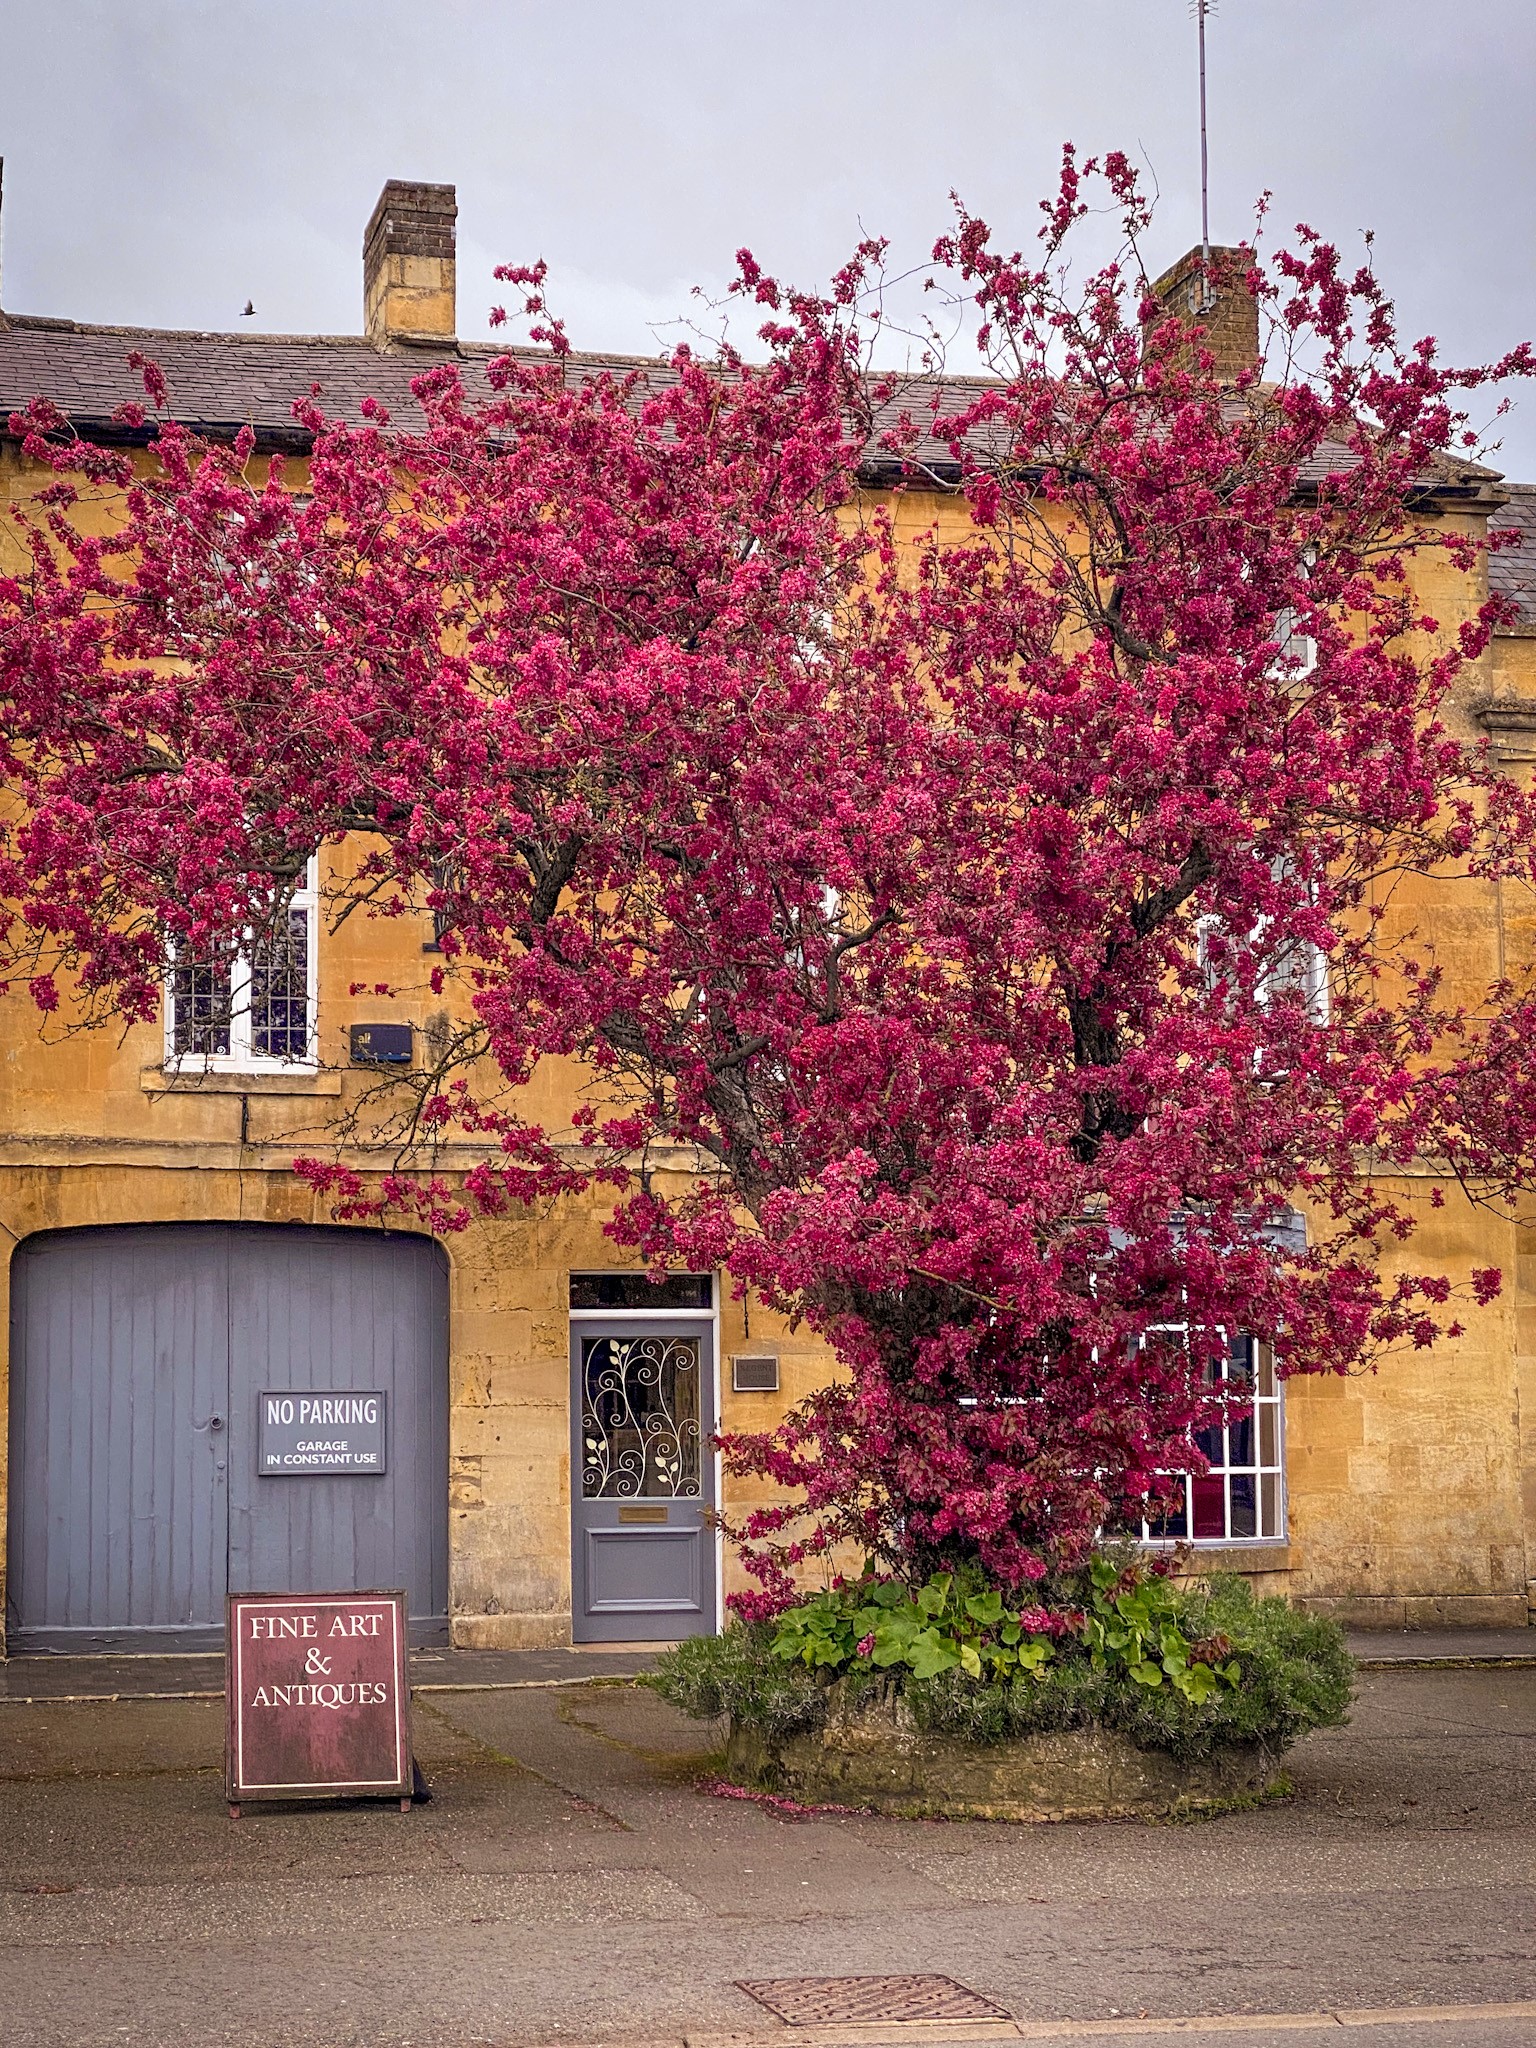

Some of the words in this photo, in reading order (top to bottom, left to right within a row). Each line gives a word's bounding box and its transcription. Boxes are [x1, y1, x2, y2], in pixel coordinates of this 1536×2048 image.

[267, 1399, 294, 1425] NO
[299, 1399, 377, 1424] PARKING
[296, 1440, 348, 1451] GARAGE
[266, 1454, 281, 1465] IN
[283, 1453, 352, 1465] CONSTANT
[353, 1453, 377, 1464] USE
[250, 1615, 318, 1639] FINE
[327, 1614, 383, 1637] ART
[304, 1647, 332, 1675] &
[251, 1682, 387, 1710] ANTIQUES
